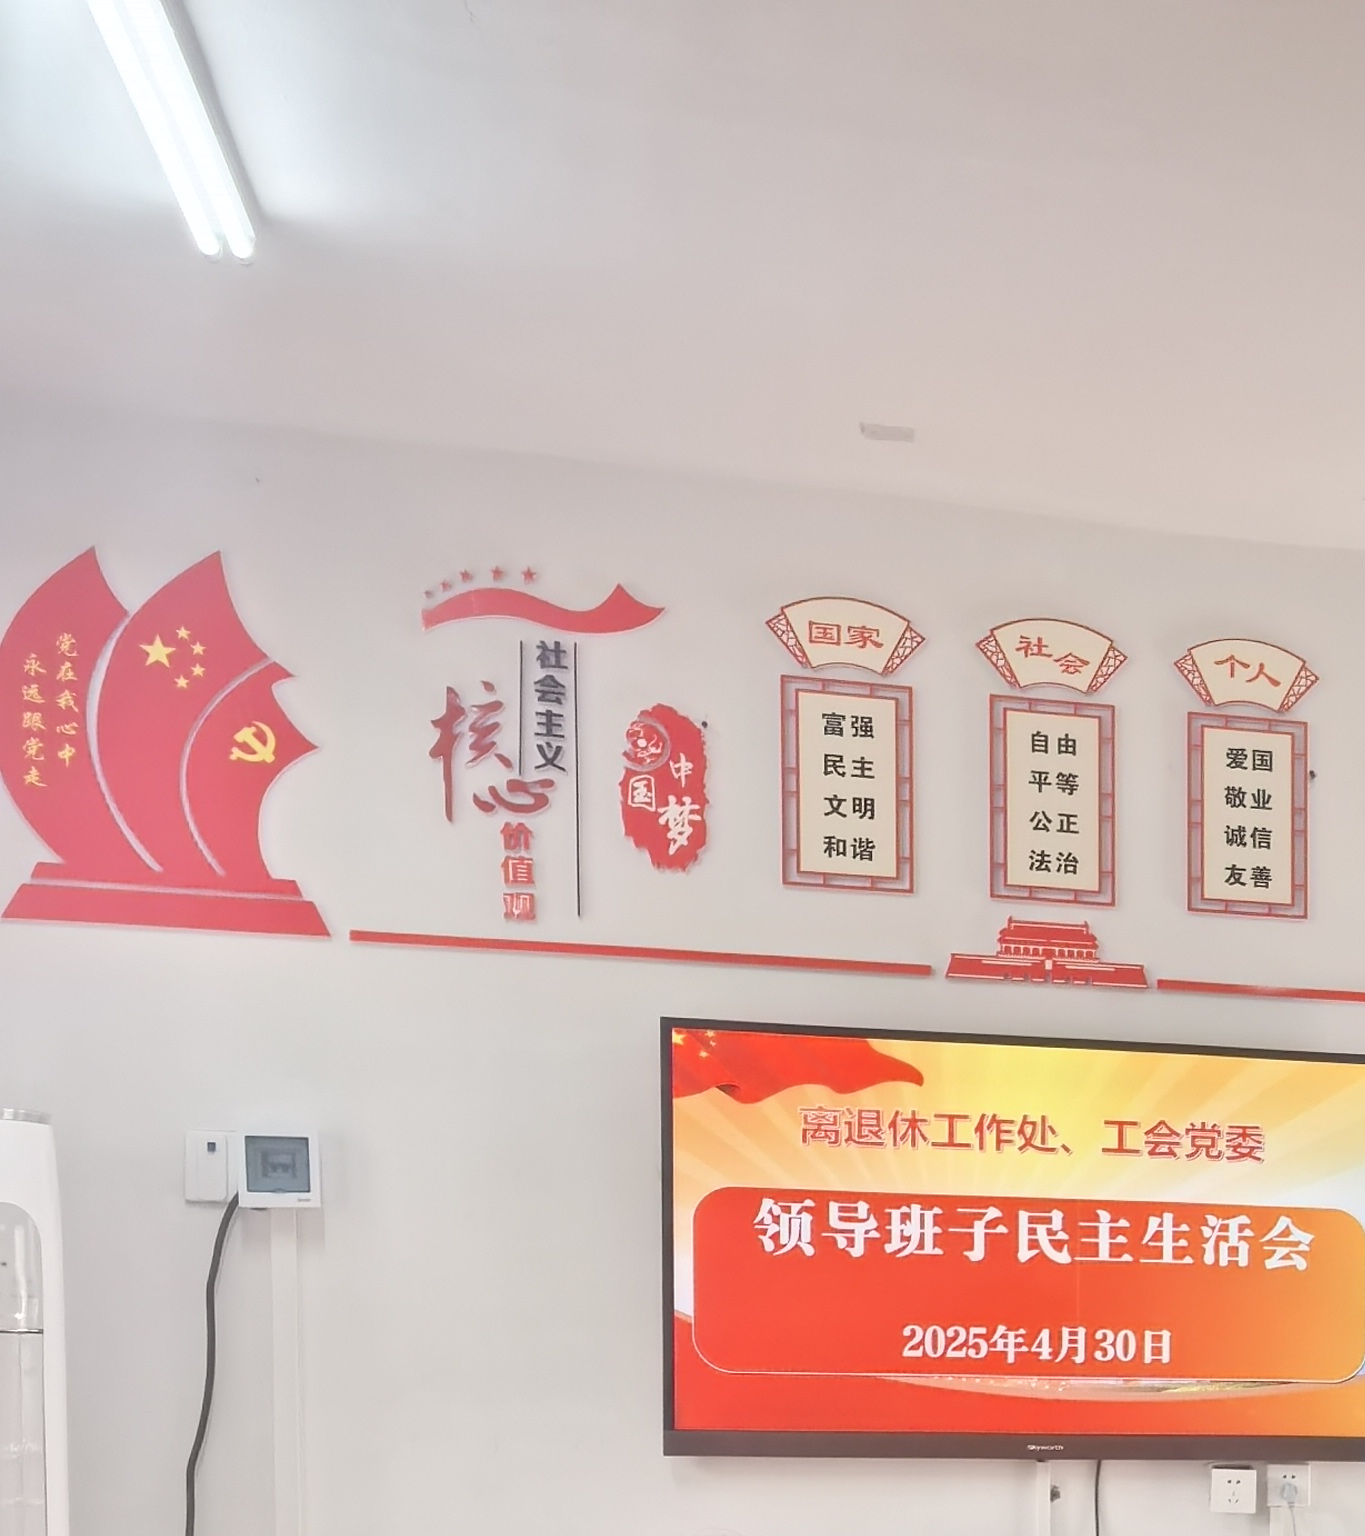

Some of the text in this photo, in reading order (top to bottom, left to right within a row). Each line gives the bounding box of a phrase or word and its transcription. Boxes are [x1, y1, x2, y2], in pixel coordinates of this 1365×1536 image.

[808, 620, 884, 650] 国家
[1015, 635, 1090, 676] 社会
[1213, 654, 1281, 688] 个人
[56, 633, 79, 767] 党在我心中
[534, 640, 569, 774] 社会主义
[22, 654, 47, 787] 永远跟党走
[821, 712, 875, 741] 富强
[430, 681, 556, 822] 核心
[1030, 730, 1078, 757] 自由
[821, 754, 876, 780] 民主
[1225, 748, 1274, 773] 爱国
[1029, 770, 1080, 795] 平等
[823, 794, 876, 821] 文明
[1224, 786, 1273, 810] 敬业
[1029, 810, 1080, 836] 公正
[822, 835, 877, 863] 和谐
[1224, 825, 1273, 850] 诚信
[1029, 850, 1080, 876] 法治
[1224, 864, 1273, 889] 友善
[799, 1105, 1266, 1165] 离退休工作处、工会党委
[754, 1197, 1316, 1272] 领导班子民主生活会
[902, 1324, 1174, 1367] 2025年4月30日
